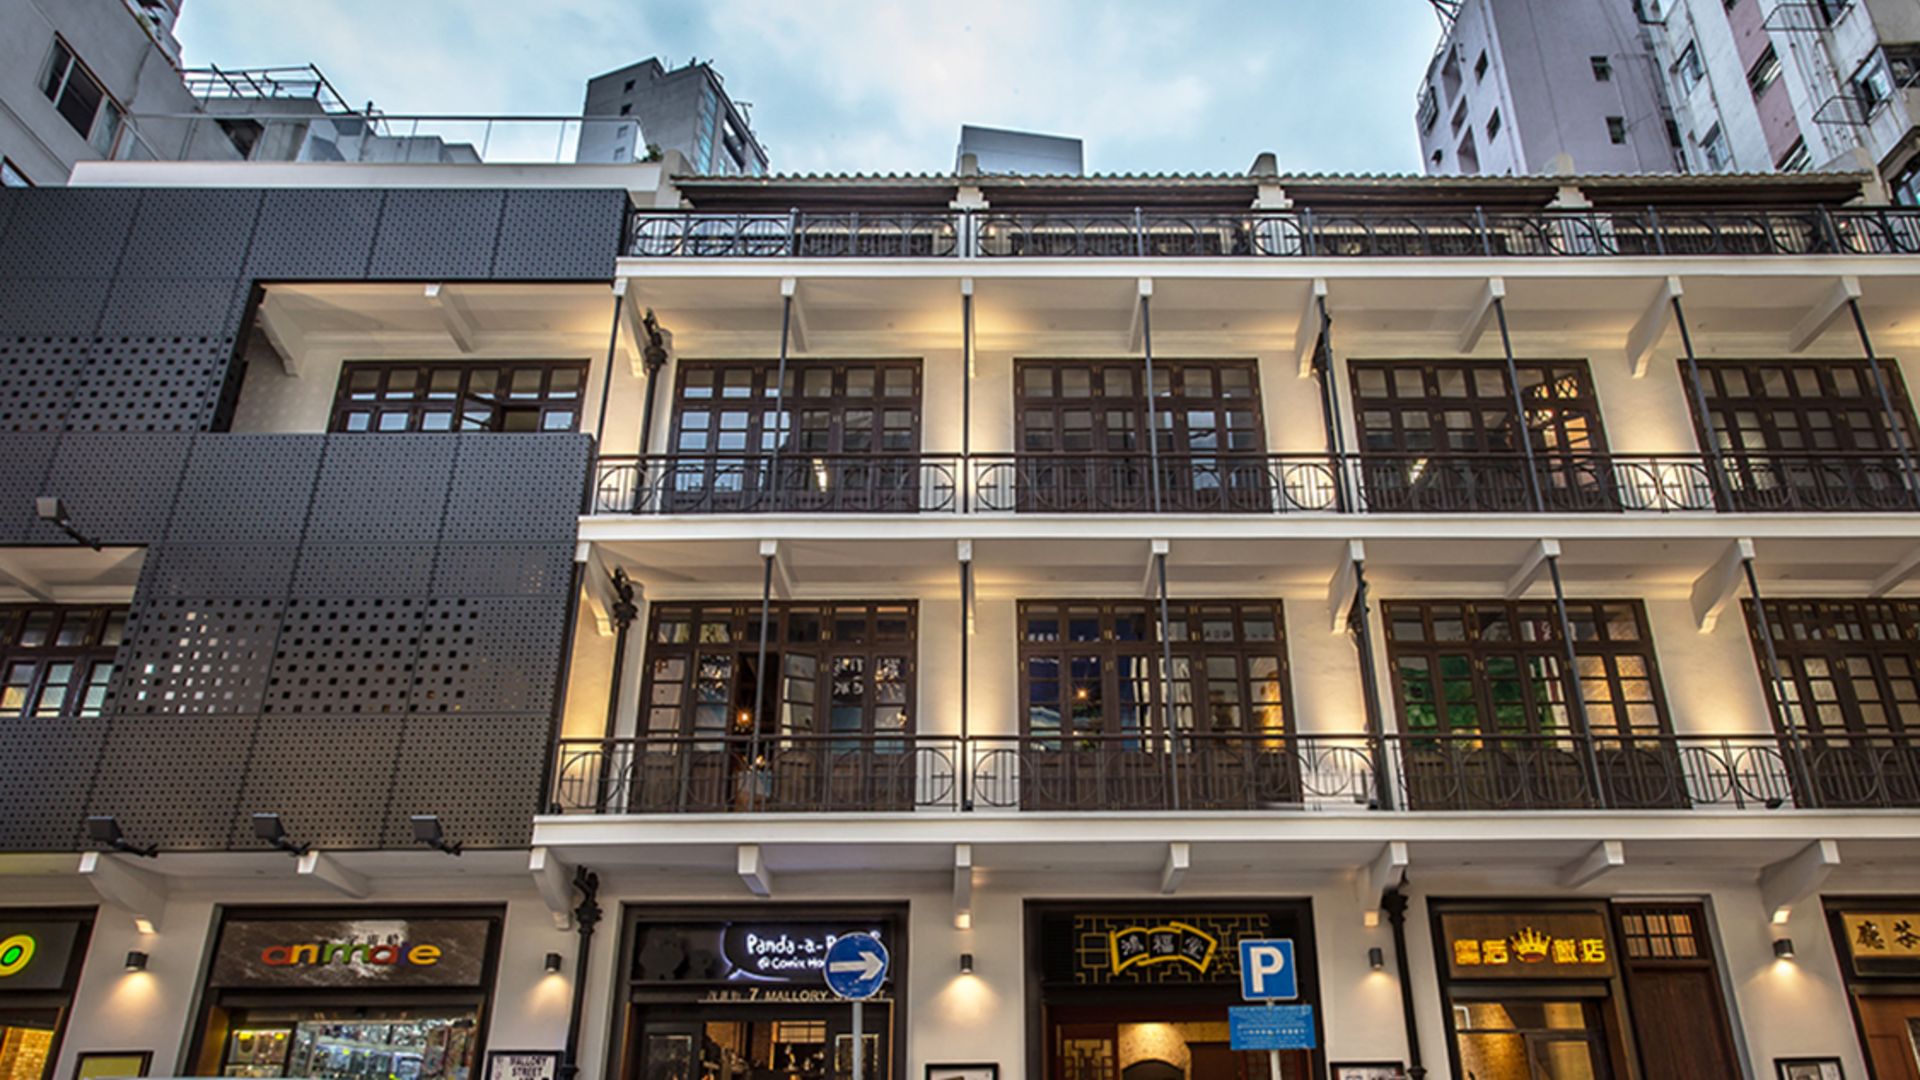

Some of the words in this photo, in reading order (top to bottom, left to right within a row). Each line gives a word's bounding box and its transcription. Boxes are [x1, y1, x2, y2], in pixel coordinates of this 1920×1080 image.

[746, 933, 837, 955] Panda-a-P
[1250, 946, 1285, 993] P
[749, 987, 760, 1001] 7
[764, 990, 828, 1001] MALLORY
